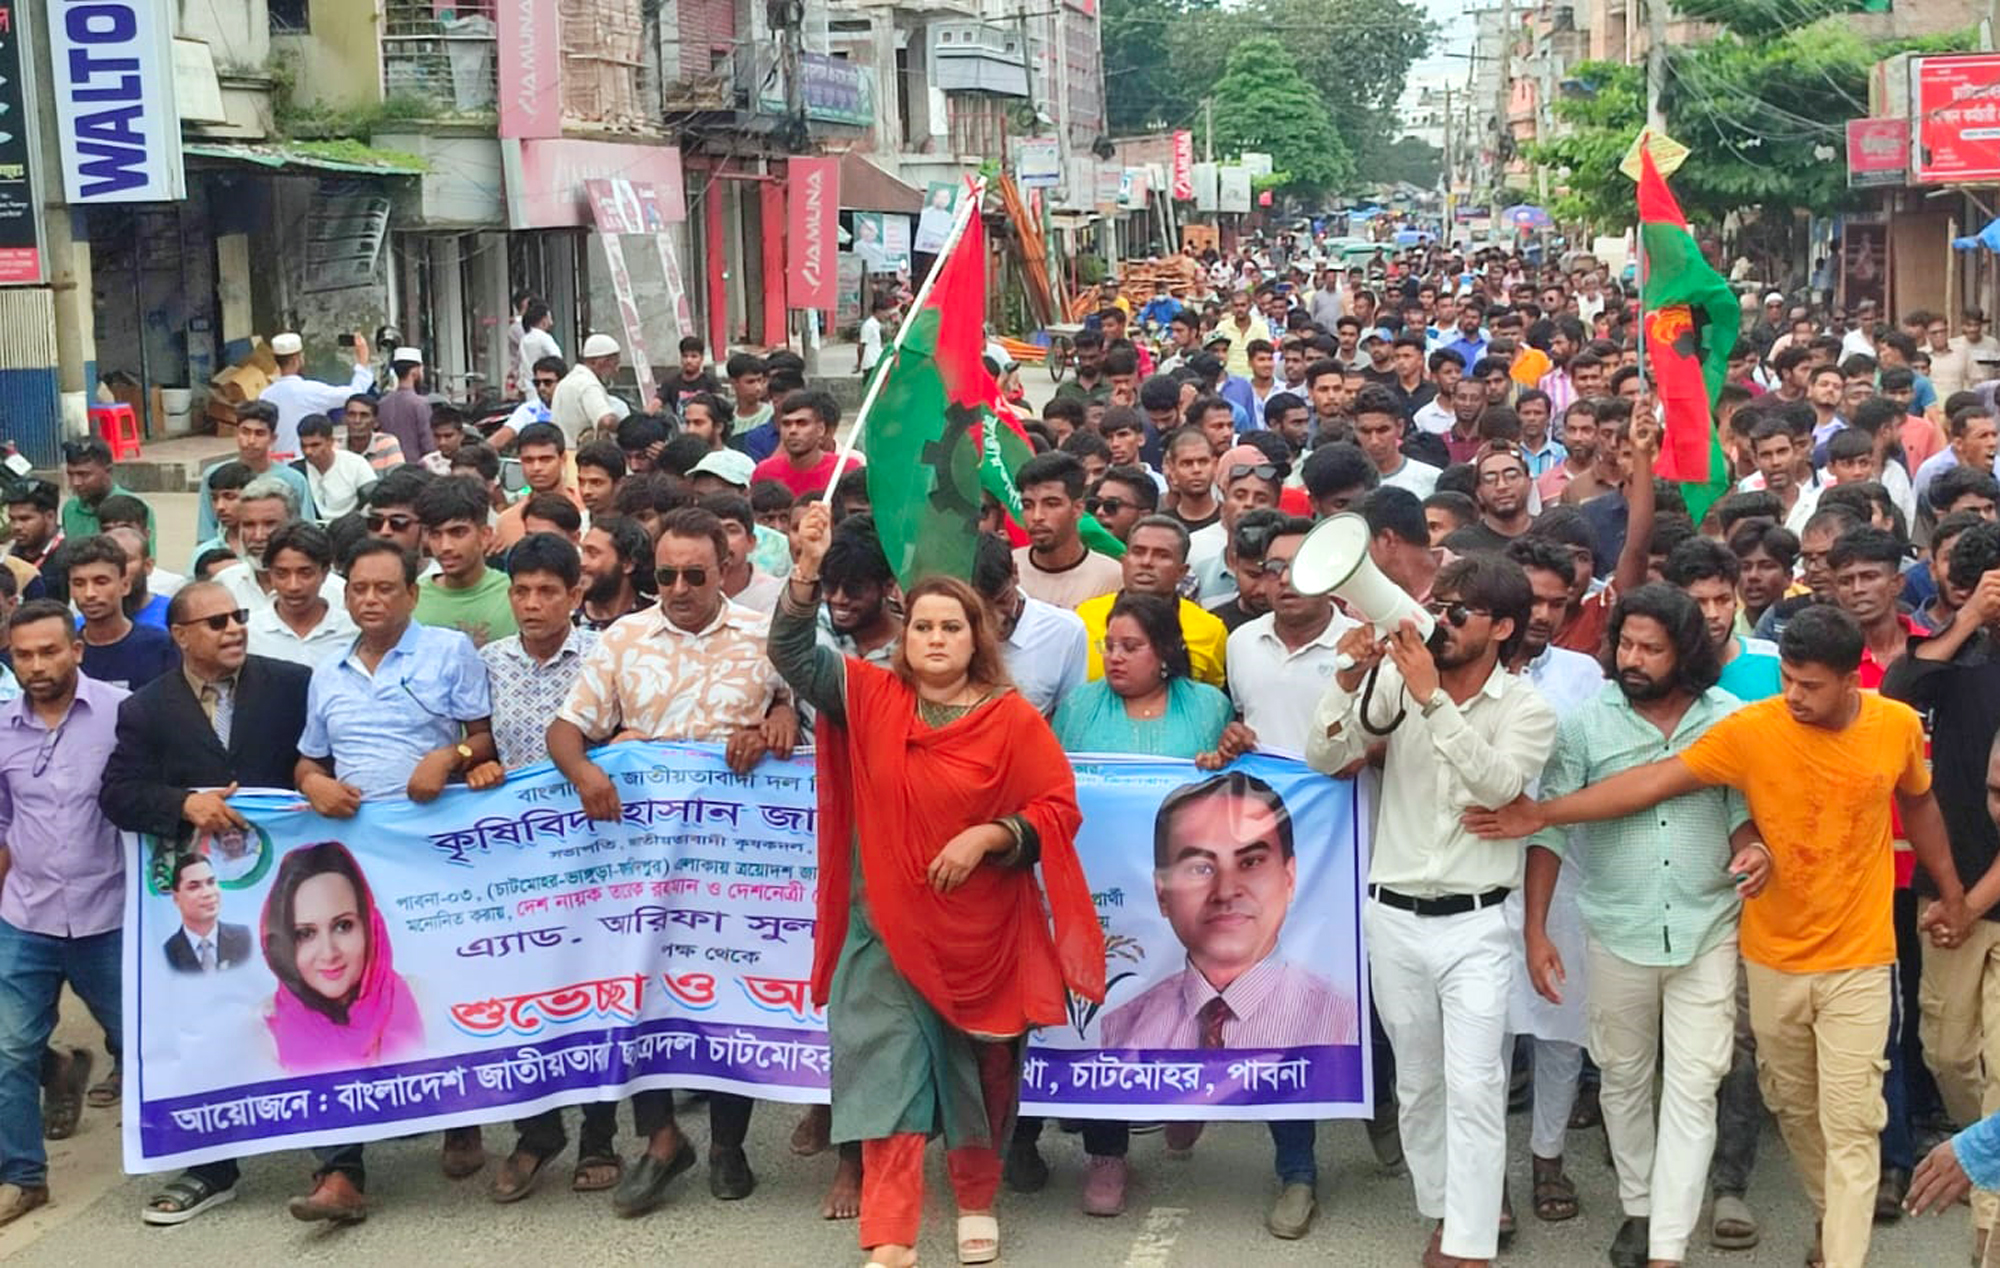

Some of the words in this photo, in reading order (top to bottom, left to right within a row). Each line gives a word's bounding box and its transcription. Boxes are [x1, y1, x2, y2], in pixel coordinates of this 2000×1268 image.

[63, 0, 149, 198] WALTO
[802, 167, 823, 296] JAMUNA
[765, 775, 800, 792] দল
[428, 808, 597, 863] কৃষিবিদ
[621, 798, 745, 827] হাসান
[758, 804, 818, 832] জা
[516, 896, 550, 917] দেশ
[554, 886, 603, 910] নায়ক
[706, 881, 723, 898] ও
[597, 904, 731, 935] আরিফা
[743, 914, 817, 944] সুল
[704, 945, 761, 965] থেকে
[450, 971, 654, 1031] শুভেচ্ছা
[663, 971, 716, 1004] ও
[170, 1089, 311, 1135] আয়োজনে
[333, 1065, 468, 1114] বাংলাদেশ
[1227, 1056, 1312, 1092] পাবনা
